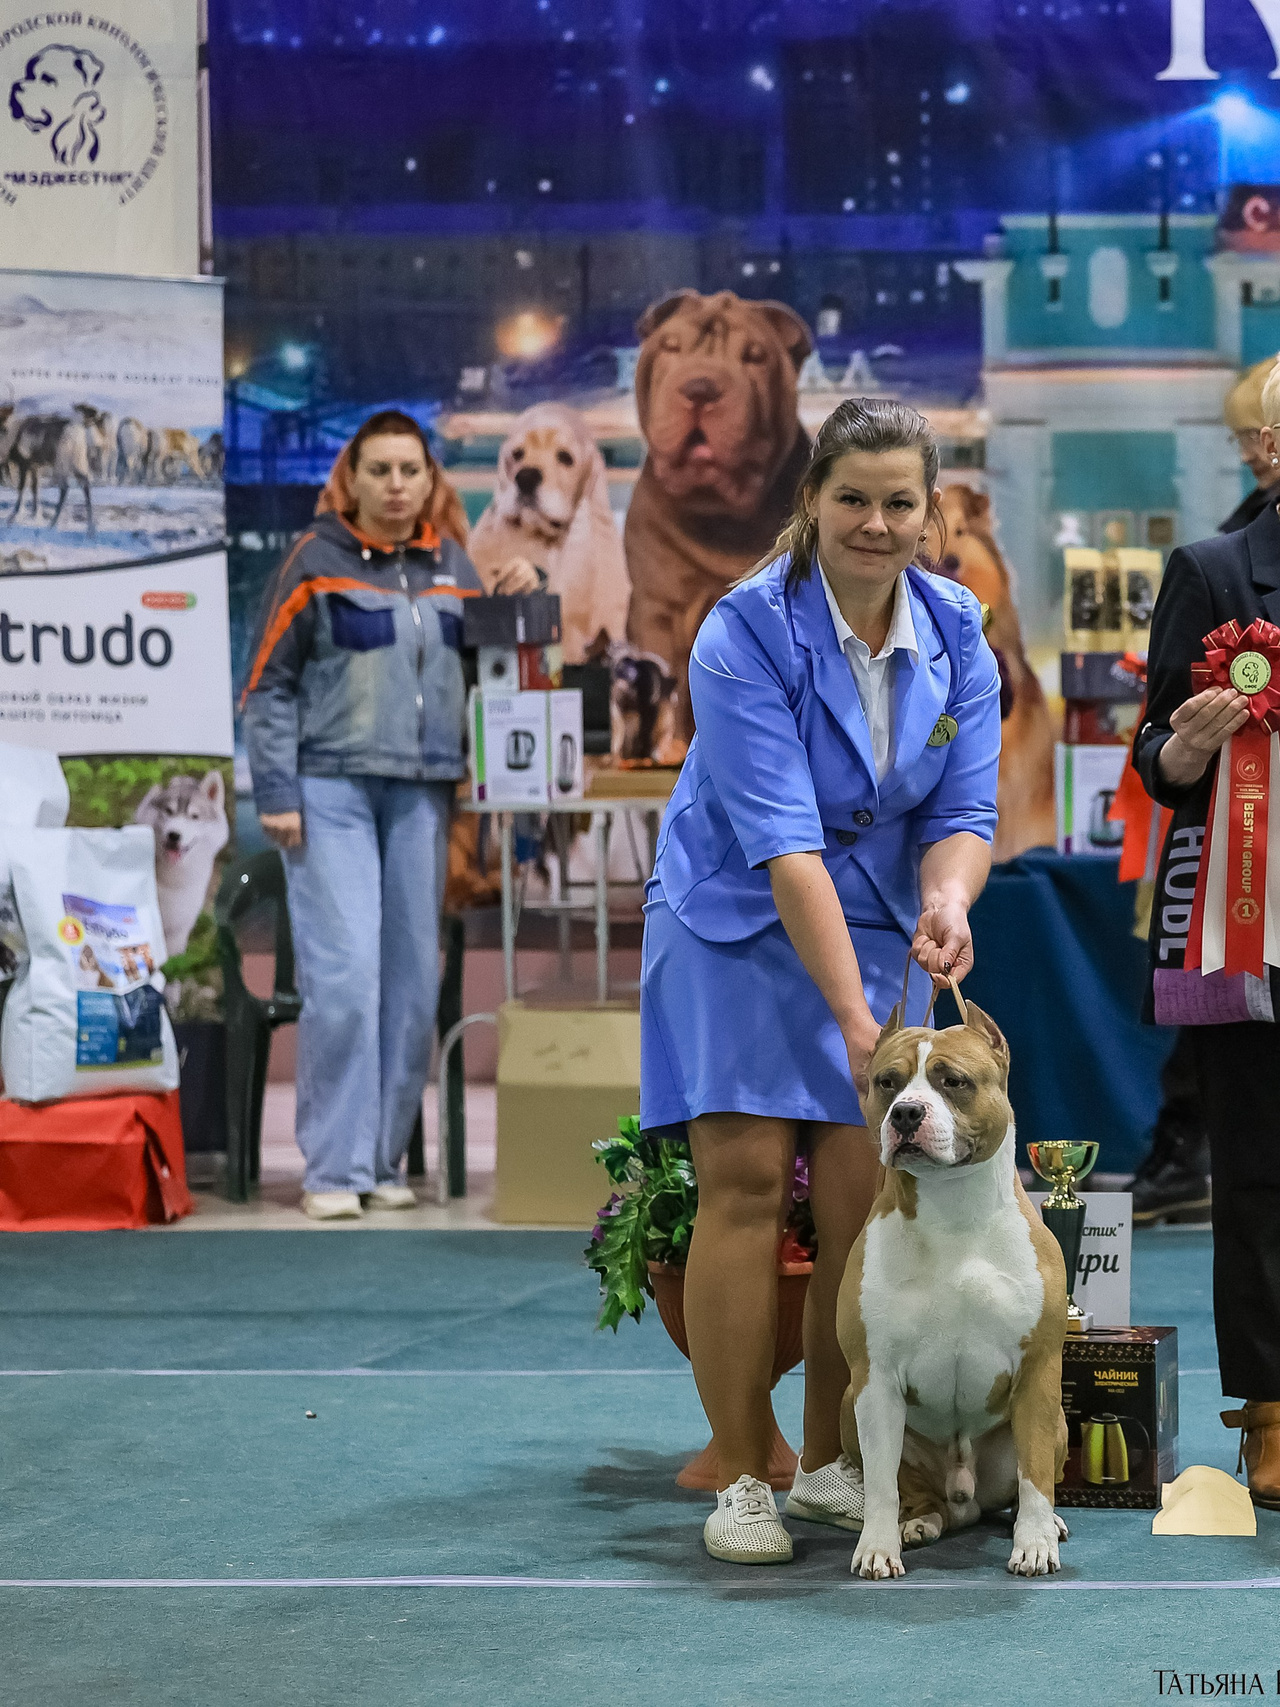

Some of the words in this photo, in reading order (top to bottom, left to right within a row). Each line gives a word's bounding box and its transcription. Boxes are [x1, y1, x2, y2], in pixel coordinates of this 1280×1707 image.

[0, 611, 172, 668] trudo
[1243, 802, 1255, 828] BEST
[1243, 836, 1253, 848] IN
[1241, 851, 1253, 894] GROUP
[1242, 904, 1252, 917] 1
[1094, 1368, 1139, 1380] ЧАЙНИК
